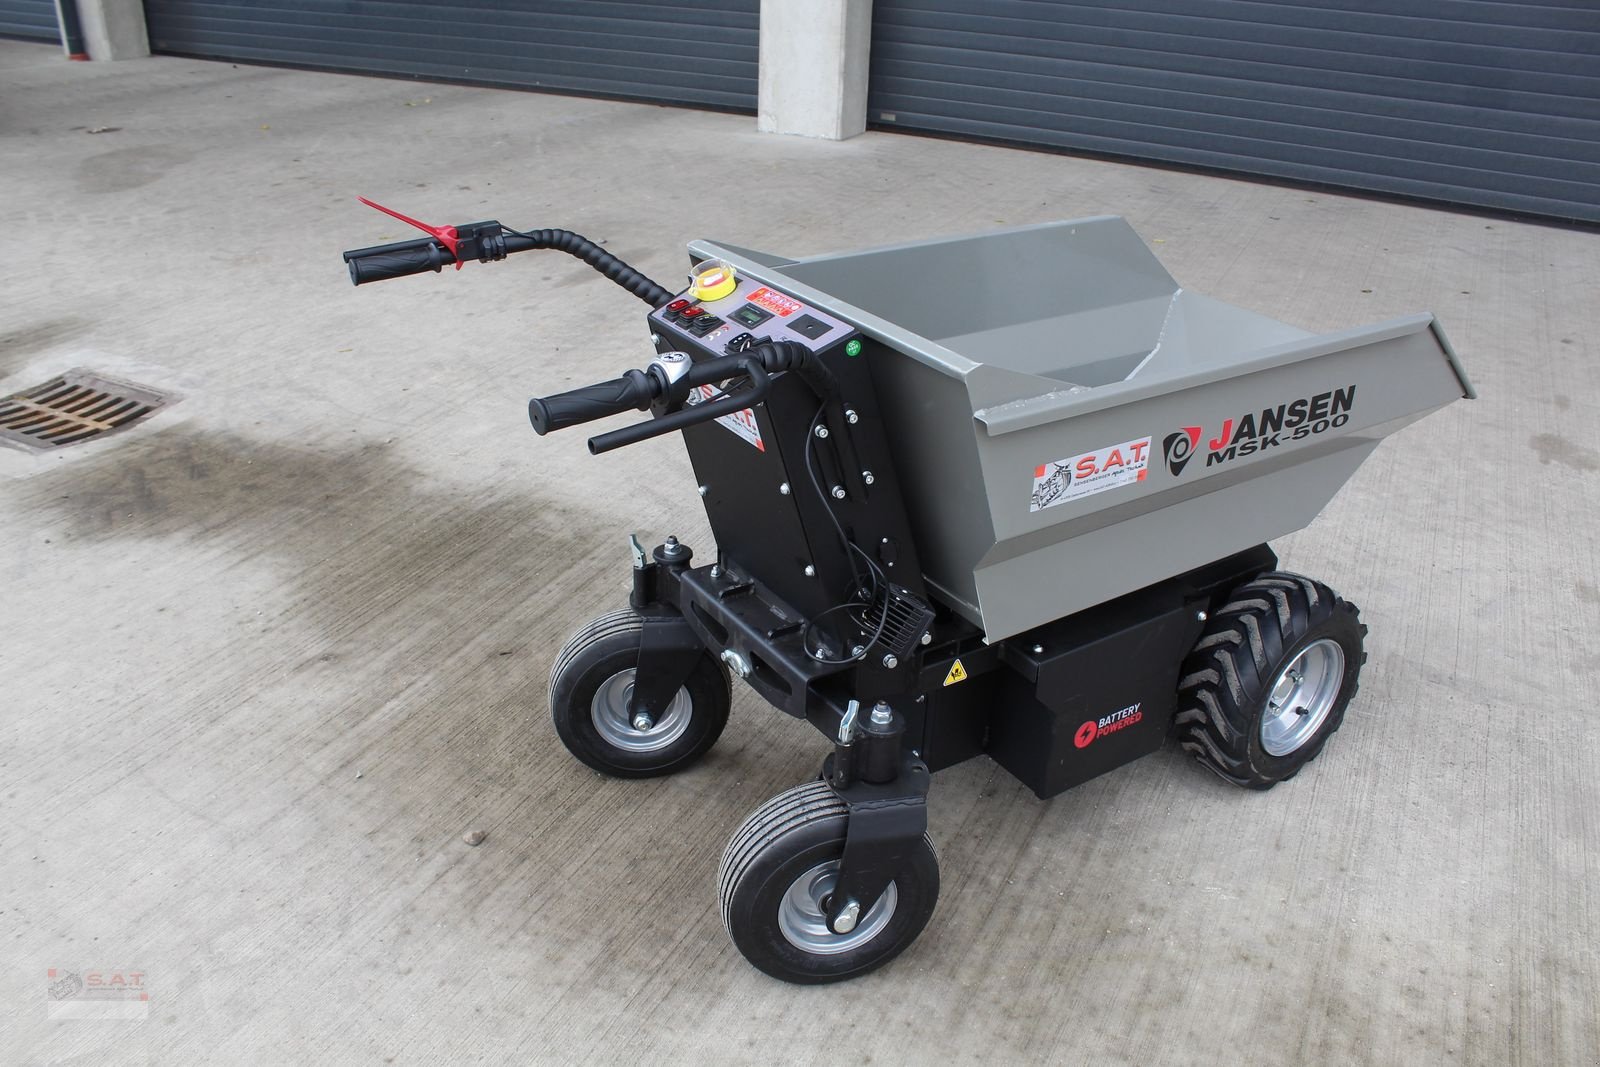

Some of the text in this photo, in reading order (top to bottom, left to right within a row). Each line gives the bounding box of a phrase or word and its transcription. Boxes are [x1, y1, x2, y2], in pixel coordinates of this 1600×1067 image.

[1209, 384, 1356, 450] JANSEN
[1206, 414, 1349, 467] MSK-500
[1075, 441, 1148, 479] S.A.T.
[1097, 712, 1142, 738] POWERED
[1098, 702, 1141, 728] BATTERY
